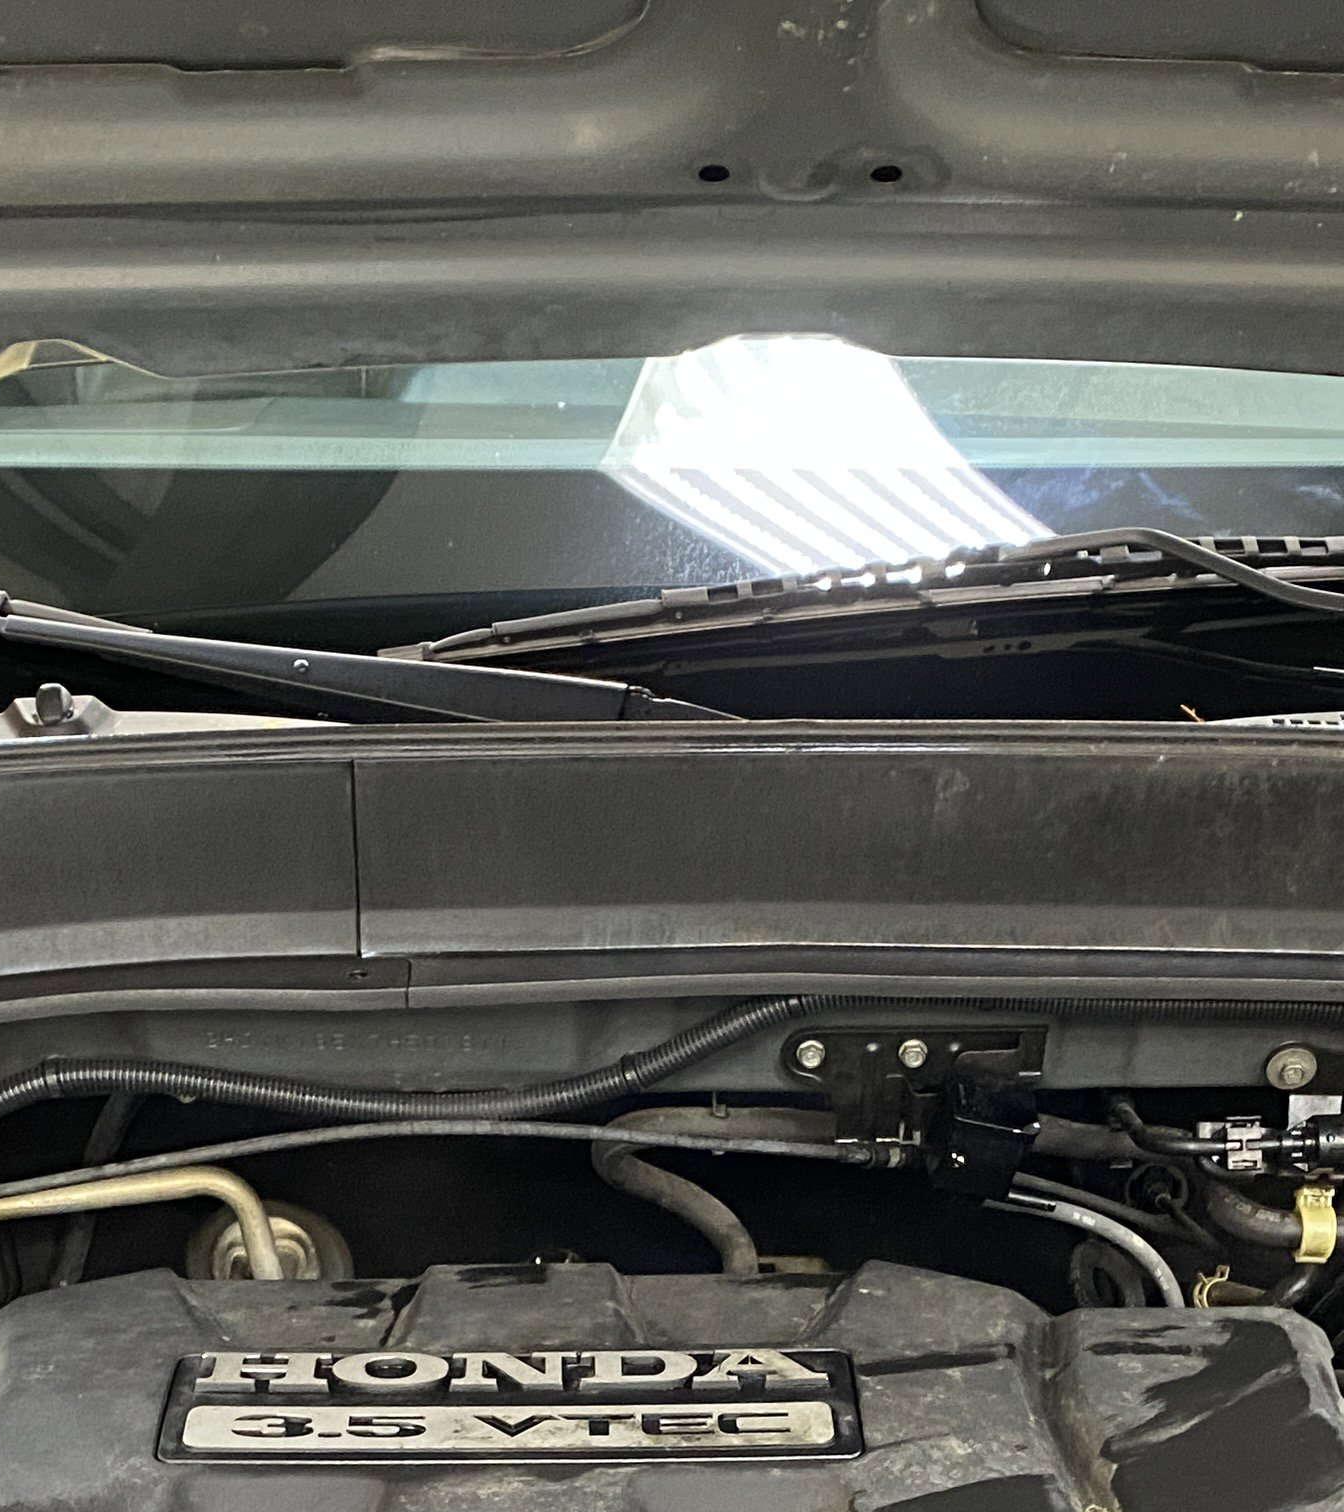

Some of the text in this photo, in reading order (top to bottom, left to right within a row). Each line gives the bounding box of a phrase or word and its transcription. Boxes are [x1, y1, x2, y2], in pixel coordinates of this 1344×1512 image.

[194, 1349, 831, 1393] HONDA
[230, 1412, 792, 1438] 3.5 VTEC
